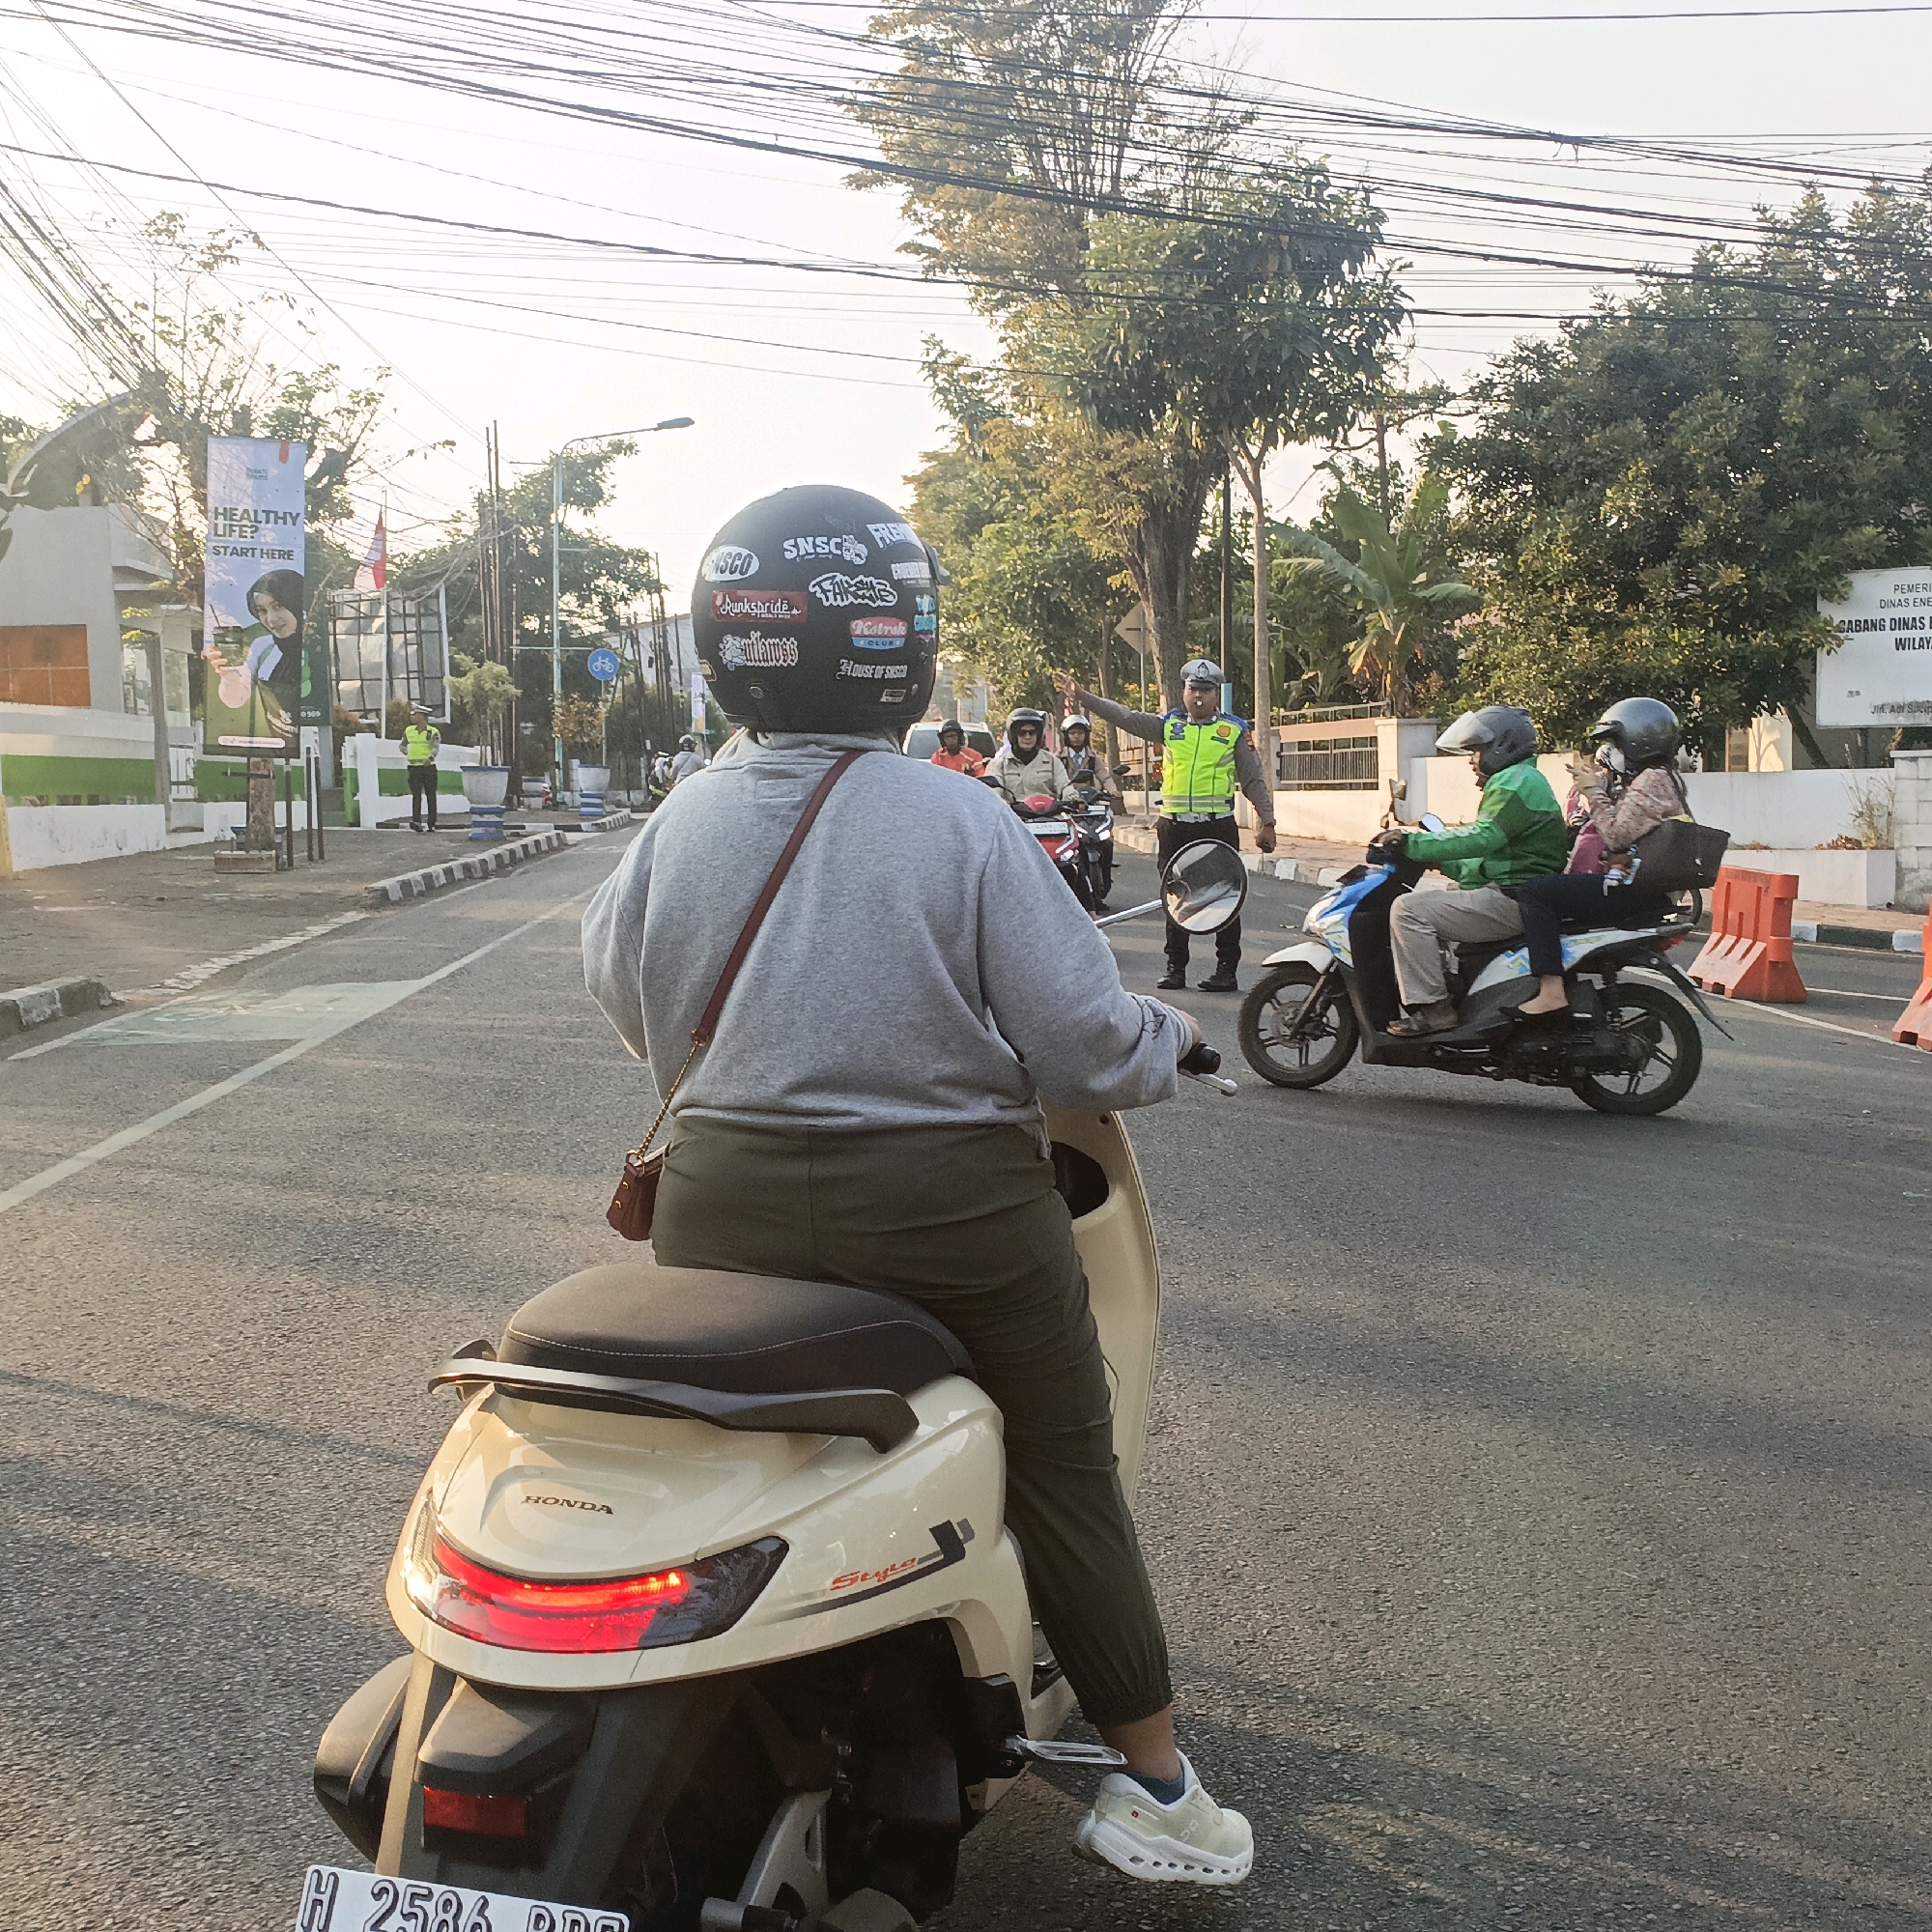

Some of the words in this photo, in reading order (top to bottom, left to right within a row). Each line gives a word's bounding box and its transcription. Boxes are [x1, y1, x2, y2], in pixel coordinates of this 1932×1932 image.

[213, 506, 300, 526] HEALTHY
[213, 523, 259, 539] LIFE?
[212, 545, 258, 558] START
[260, 548, 295, 560] HERE
[1879, 598, 1910, 610] DINAS
[1889, 616, 1925, 632] DINAS
[521, 1495, 613, 1515] HONDA
[301, 1868, 339, 1932] H
